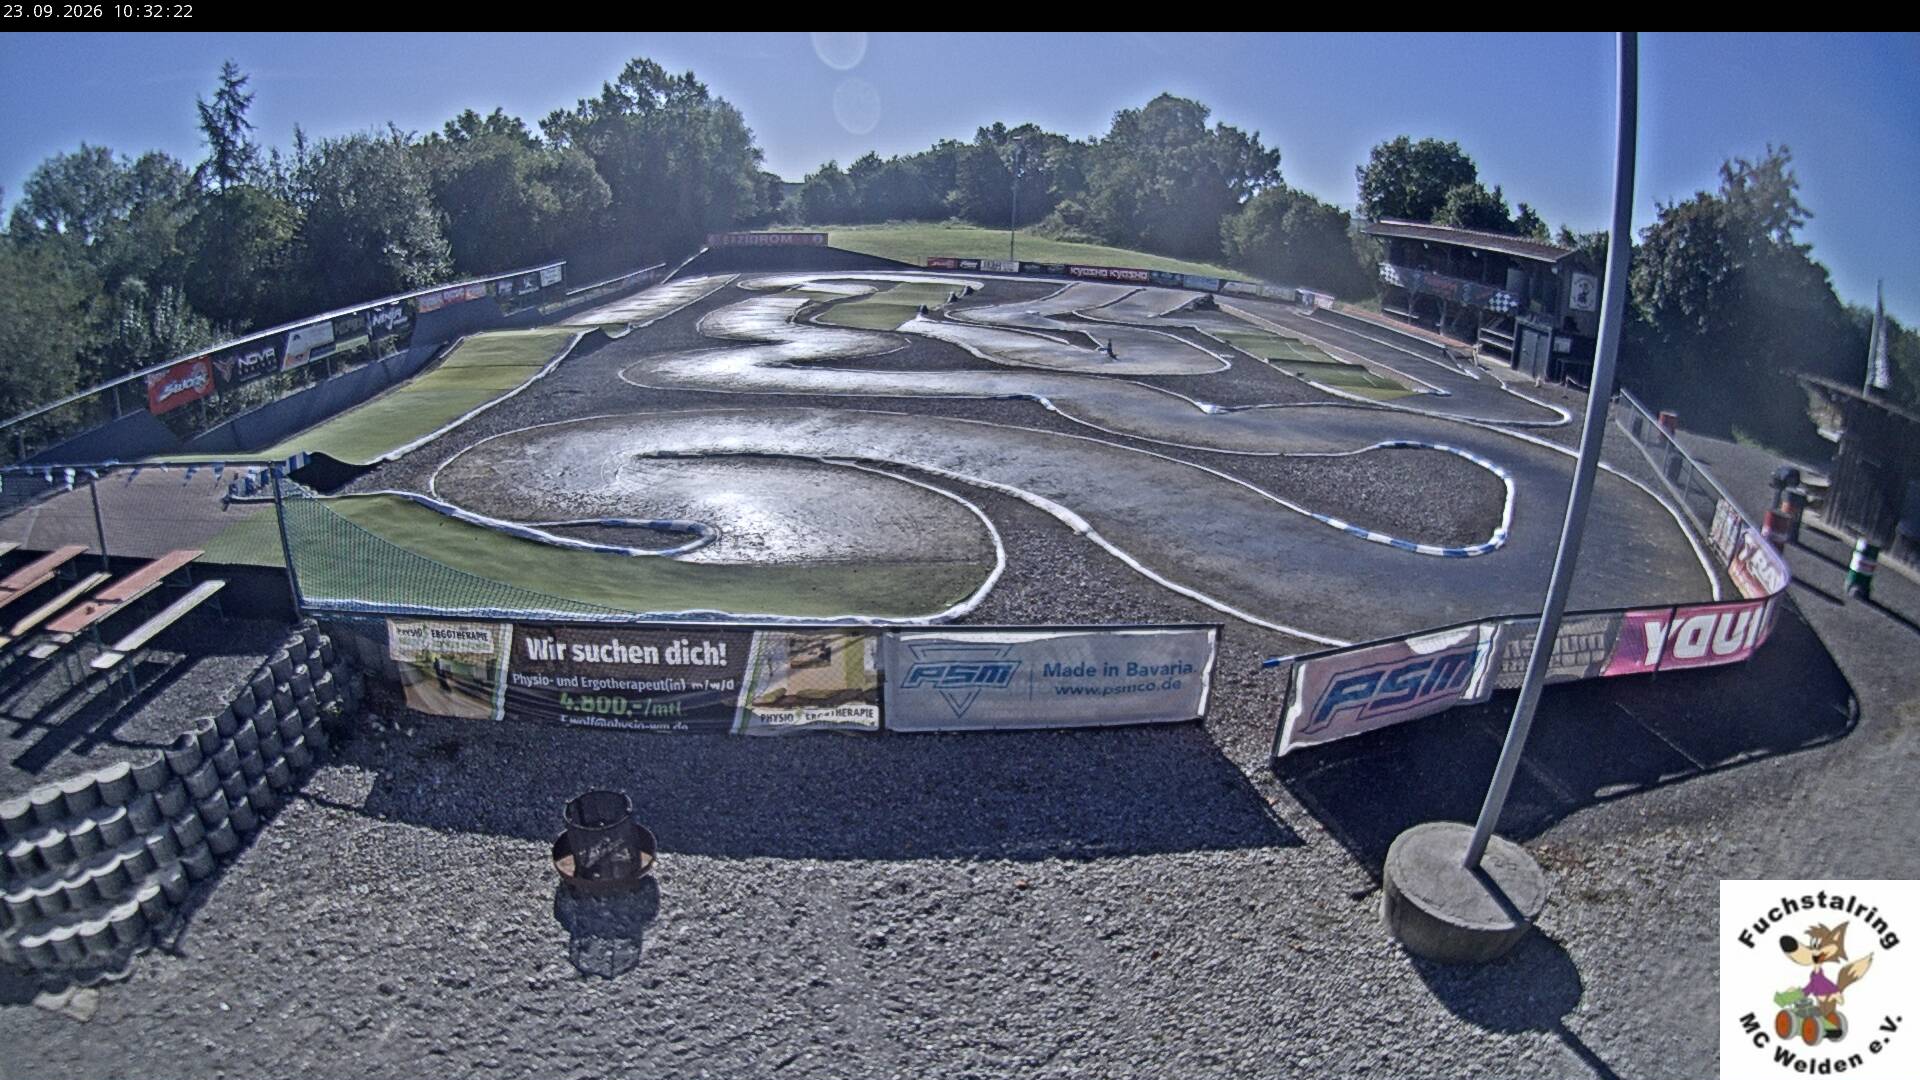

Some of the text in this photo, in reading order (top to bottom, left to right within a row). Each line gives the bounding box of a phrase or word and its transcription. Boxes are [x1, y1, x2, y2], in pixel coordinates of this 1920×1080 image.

[525, 635, 728, 667] Wir suchen dich!
[1042, 661, 1097, 678] Made
[1102, 660, 1120, 678] in
[511, 673, 735, 693] Physio- und Ergotherapeut(in) m/w/d
[1055, 677, 1182, 698] www.psmco.de
[760, 713, 794, 723] PHYSIO
